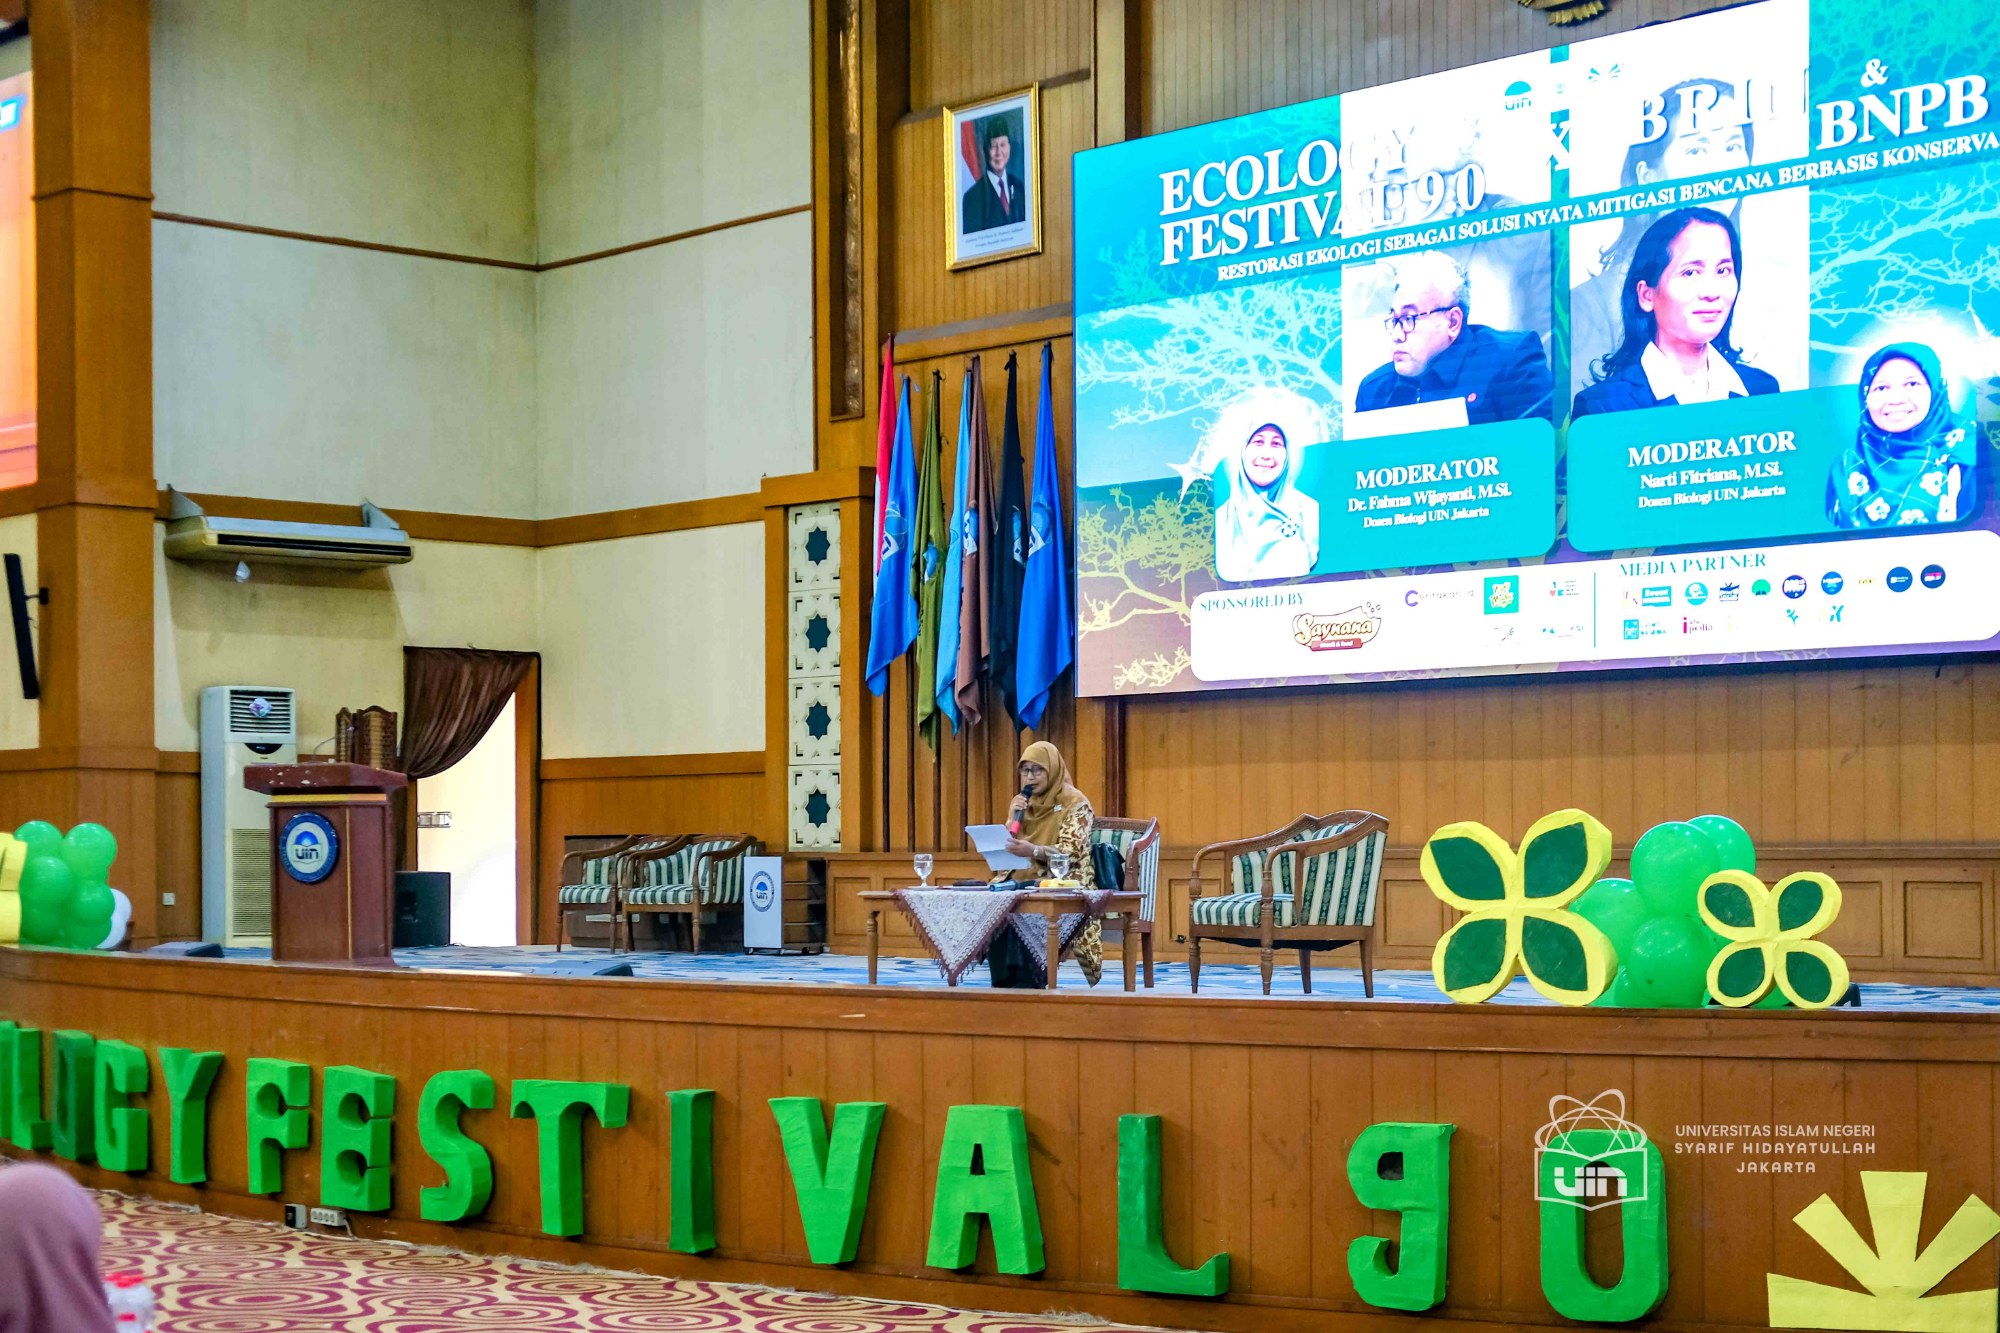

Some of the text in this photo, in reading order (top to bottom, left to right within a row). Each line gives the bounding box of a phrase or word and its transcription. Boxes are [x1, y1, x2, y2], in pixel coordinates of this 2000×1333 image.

[1860, 58, 1889, 88] &
[1816, 74, 1989, 151] BNPB
[1217, 131, 2000, 282] RESTORASI EKOLOGI SEBAGAI SOLUSI NYATA MITIGASI BENCANA BERBASIS KONSERVA
[1159, 180, 1406, 267] FESTIVAL
[1627, 430, 1797, 467] MODERATOR
[1355, 456, 1500, 490] MODERATOR
[1640, 472, 1678, 489] Narti
[1348, 498, 1368, 512] Dr.
[1638, 485, 1787, 508] Dosen Biologi UIN Jakarta
[1428, 509, 1450, 522] UIN
[1451, 507, 1490, 520] Jakarta
[1620, 553, 1767, 576] MEDIA PARTNER
[1200, 592, 1306, 612] SPONSORED BY
